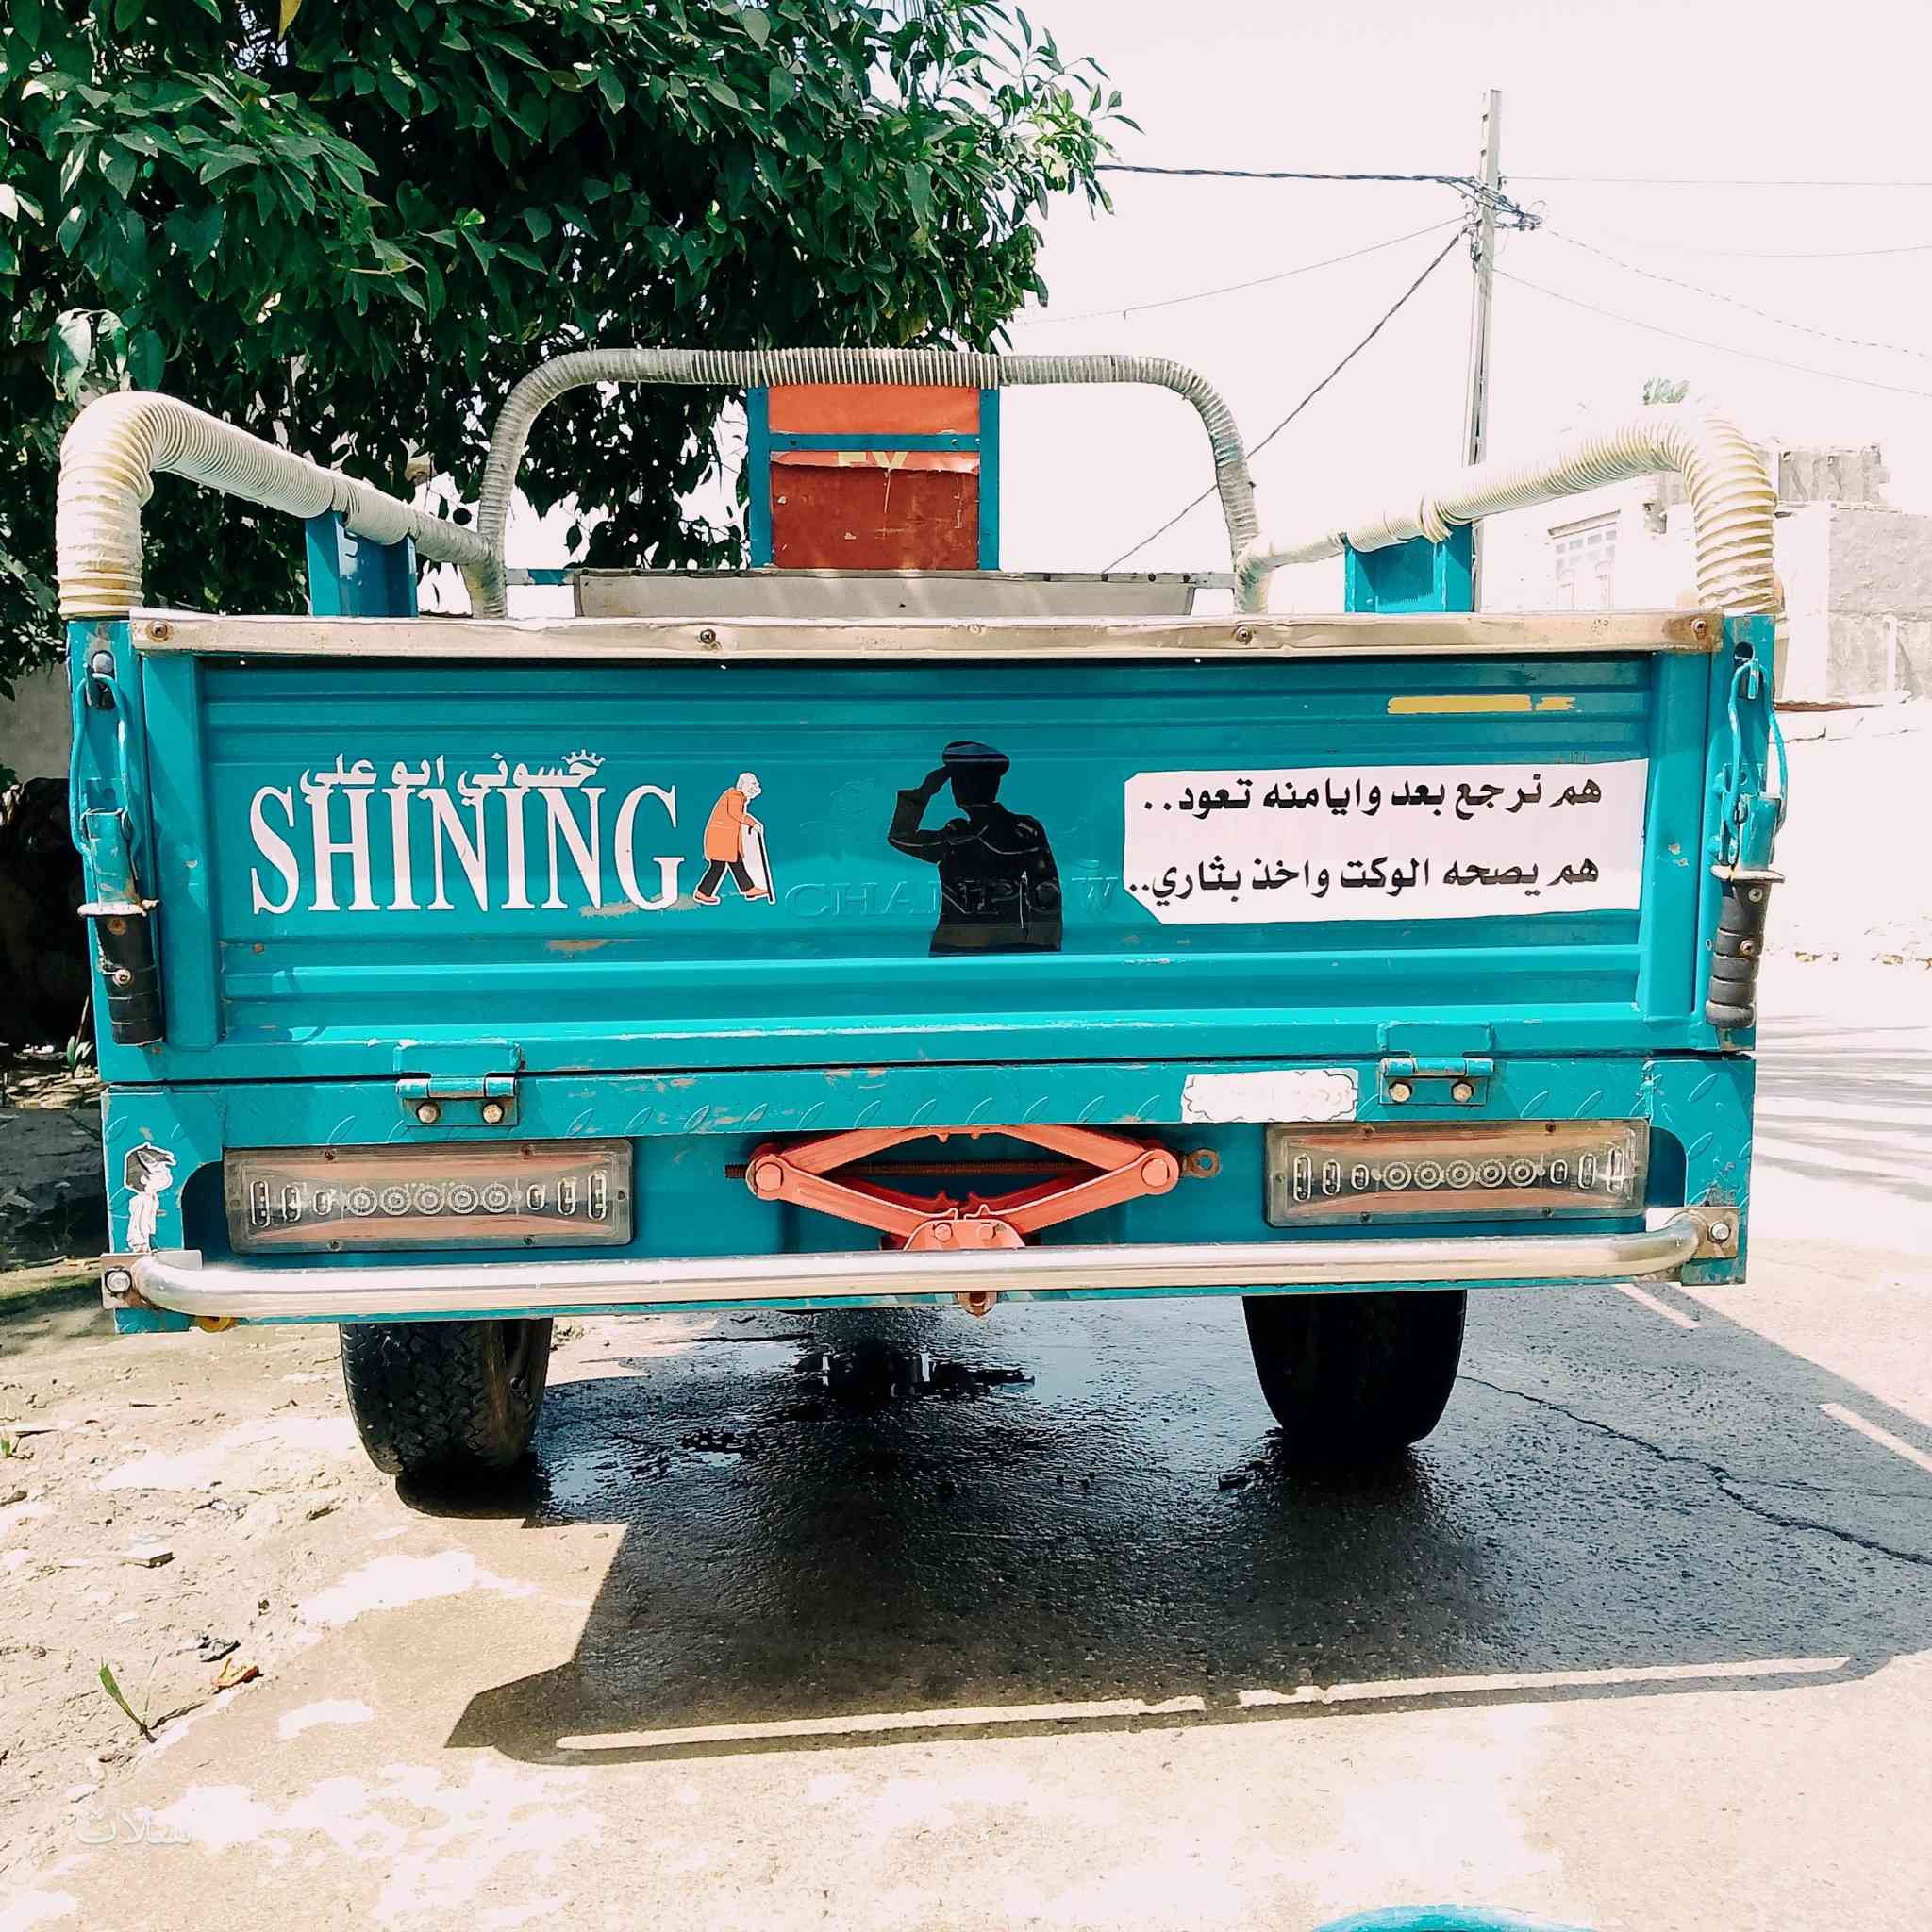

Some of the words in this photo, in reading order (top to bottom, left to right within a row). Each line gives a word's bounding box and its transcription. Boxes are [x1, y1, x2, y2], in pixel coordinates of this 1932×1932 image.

[299, 754, 377, 804] علي
[391, 755, 446, 798] ابو
[1455, 773, 1542, 820] نرجع
[1548, 778, 1602, 808] هم
[1391, 779, 1445, 817] بعد
[250, 784, 685, 914] SHINING
[1251, 858, 1330, 898] واخذ
[1340, 855, 1429, 897] الوكت
[1442, 859, 1539, 897] يصحه
[1546, 858, 1599, 886] هم
